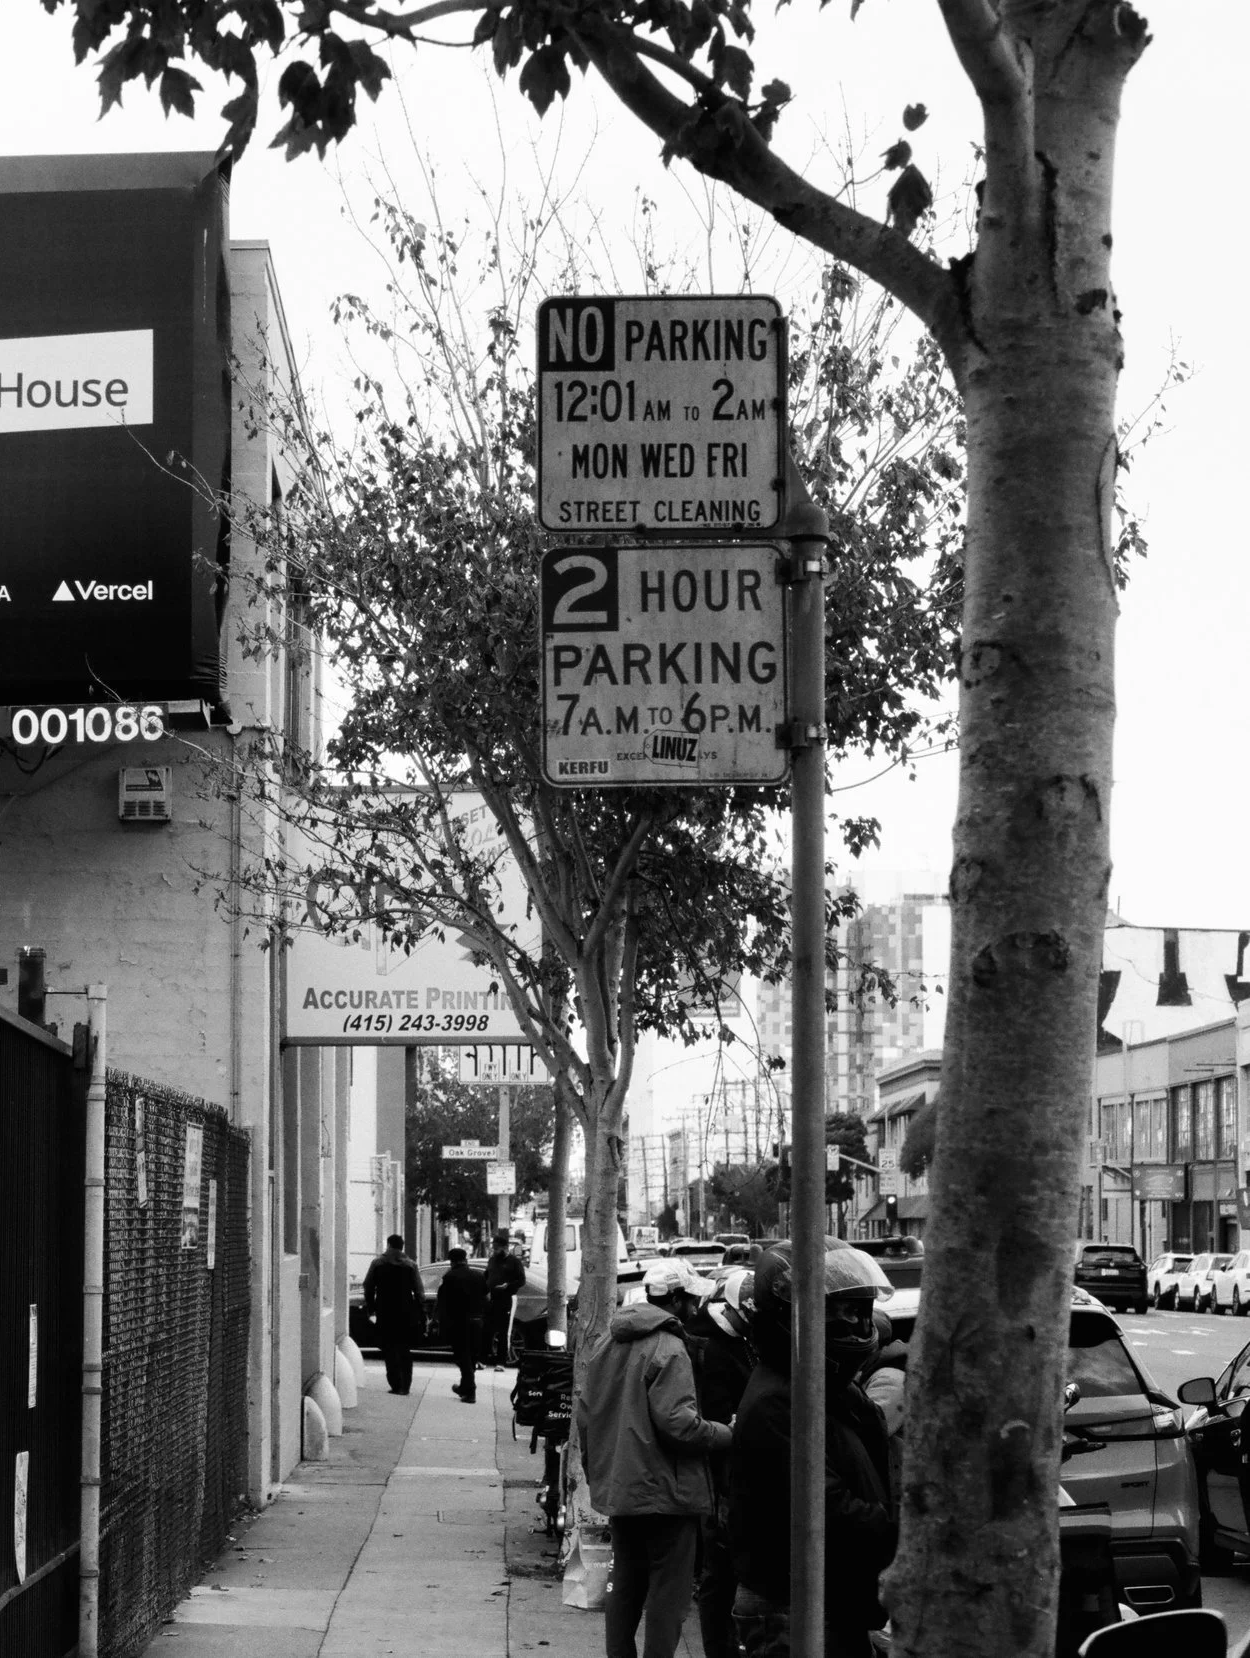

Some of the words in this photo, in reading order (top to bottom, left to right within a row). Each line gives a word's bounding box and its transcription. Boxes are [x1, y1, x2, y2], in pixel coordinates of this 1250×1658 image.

[550, 306, 605, 362] NO
[625, 319, 768, 362] PARKING
[684, 405, 700, 422] TO
[572, 443, 627, 479] MON
[641, 443, 695, 479] WED
[707, 442, 748, 478] FRI
[559, 501, 639, 523] STREET
[654, 500, 761, 522] CLEANING
[75, 580, 153, 601] Vercel
[553, 555, 608, 624] 2
[641, 569, 762, 613] HOUR
[554, 642, 778, 686] PARKING
[12, 706, 164, 745] 001086
[648, 707, 673, 726] TO
[559, 761, 609, 775] KERFU
[302, 987, 419, 1010] ACCURATE
[426, 988, 514, 1011] PRINTIN
[343, 1014, 393, 1033] (415)
[398, 1014, 490, 1031] 243-3998
[467, 1149, 493, 1157] Grove
[881, 1160, 895, 1168] 25
